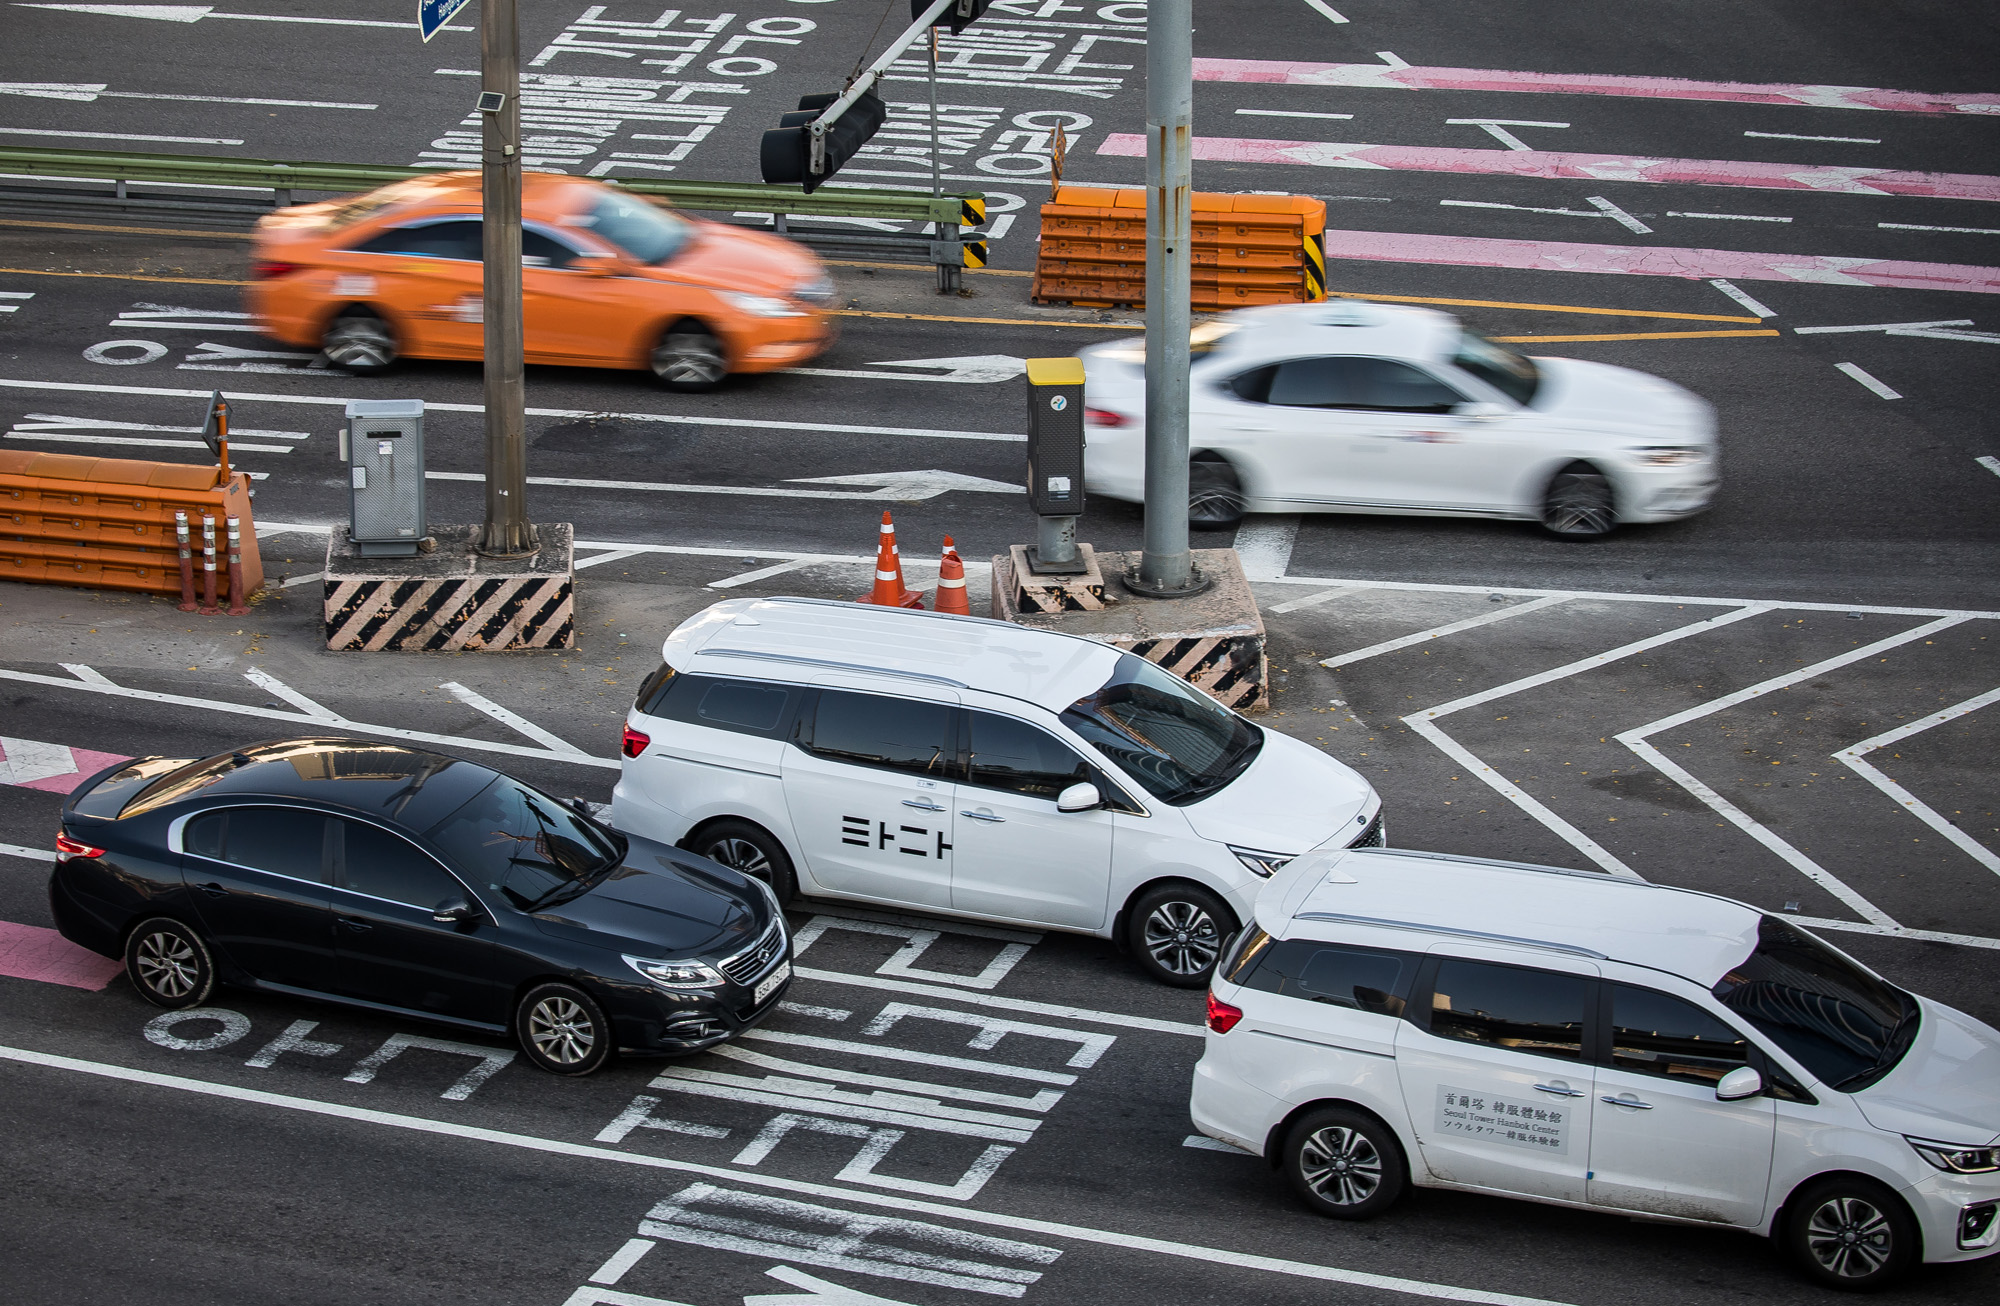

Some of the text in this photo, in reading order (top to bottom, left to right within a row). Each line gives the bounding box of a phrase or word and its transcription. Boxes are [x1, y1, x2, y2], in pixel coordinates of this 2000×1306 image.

[1443, 1108, 1560, 1136] Seoul Tower Hanbok Center
